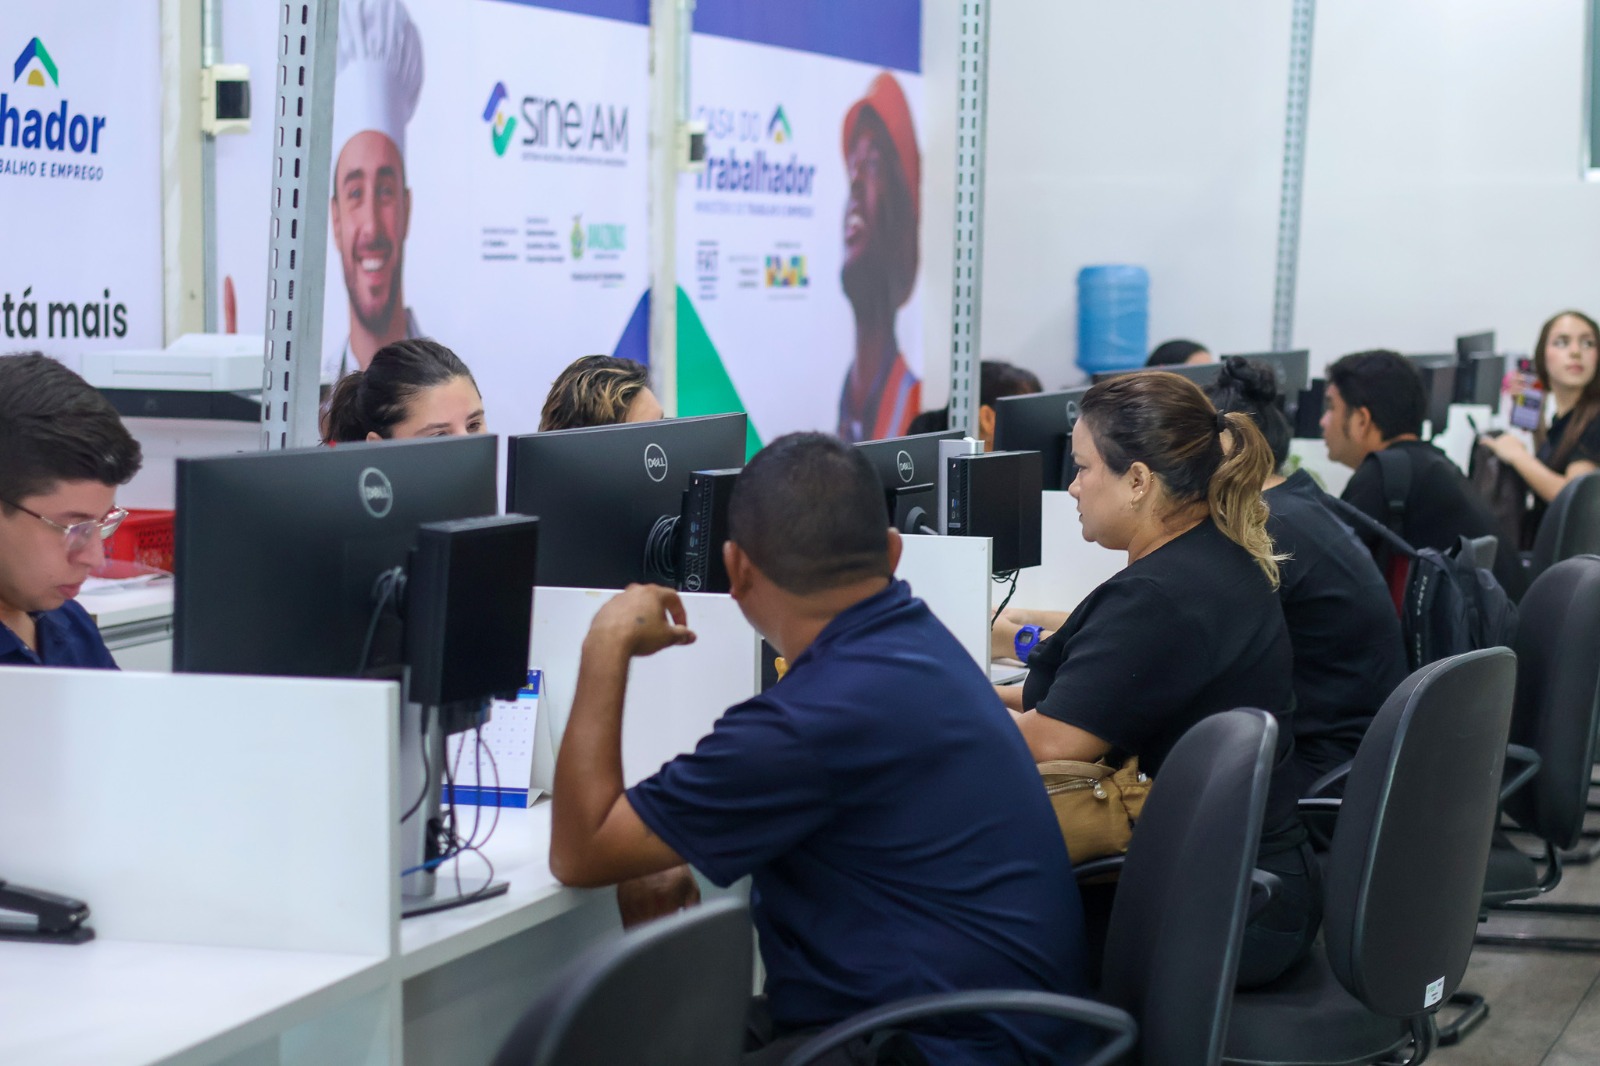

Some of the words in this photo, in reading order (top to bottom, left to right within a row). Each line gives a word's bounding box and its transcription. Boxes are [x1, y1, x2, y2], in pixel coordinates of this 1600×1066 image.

[40, 162, 47, 177] E
[50, 162, 104, 181] EMPREGO
[48, 288, 127, 339] mais
